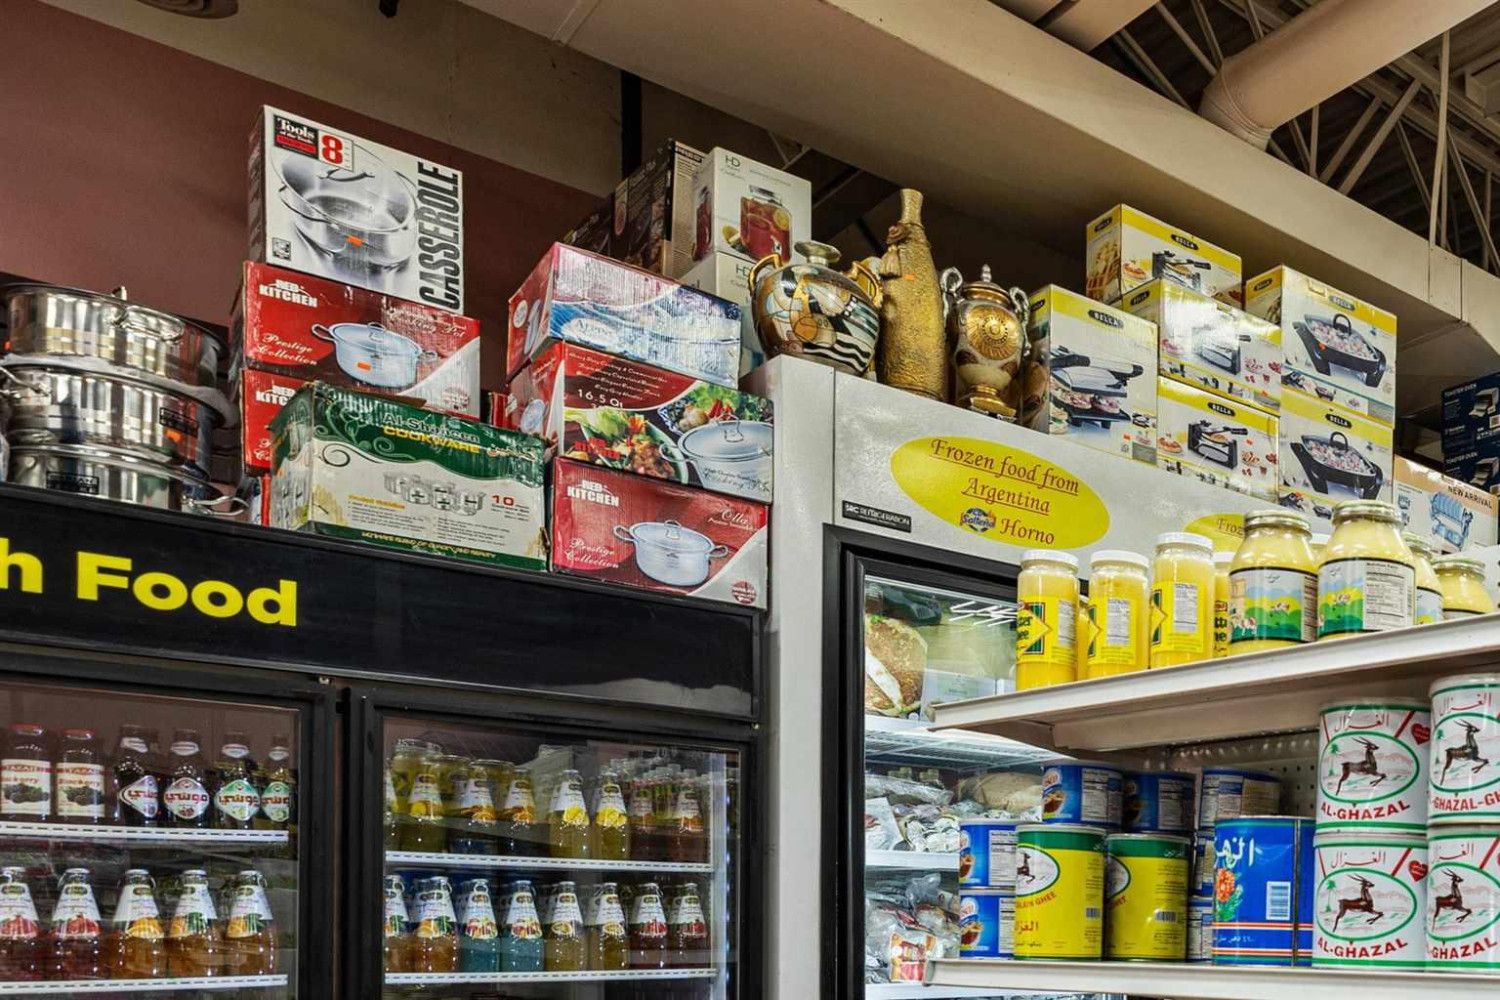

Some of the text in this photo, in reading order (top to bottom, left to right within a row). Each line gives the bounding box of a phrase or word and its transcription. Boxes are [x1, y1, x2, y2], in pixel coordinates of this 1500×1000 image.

[277, 117, 315, 139] Tools
[321, 133, 344, 165] 8
[416, 161, 461, 312] CASSEROLE
[1172, 235, 1197, 249] BELLA
[258, 284, 318, 308] KITCHEN
[1093, 311, 1120, 327] BELLA
[255, 343, 318, 366] Collection
[262, 333, 314, 354] Prestige
[256, 391, 296, 406] KITC
[1209, 402, 1232, 416] BELLA
[383, 412, 481, 445] Al-Shaheen
[1327, 413, 1349, 428] BELLA
[383, 425, 480, 454] COOKWARE
[930, 438, 1080, 493] Frozen food from
[491, 494, 515, 507] 10
[567, 485, 620, 507] KITCHEN
[961, 477, 1050, 513] Argentina
[1448, 485, 1493, 510] NEW ARRIVAL
[1001, 518, 1055, 545] Horno
[1218, 517, 1245, 535] Froz
[569, 537, 615, 556] Prestige
[564, 550, 620, 569] Collection
[77, 550, 297, 627] Food
[1321, 800, 1411, 821] AL-GHAZAL
[1035, 891, 1056, 905] GHEE
[1317, 937, 1409, 959] AL-GHAZAL
[1428, 937, 1498, 960] -GHAZAL
